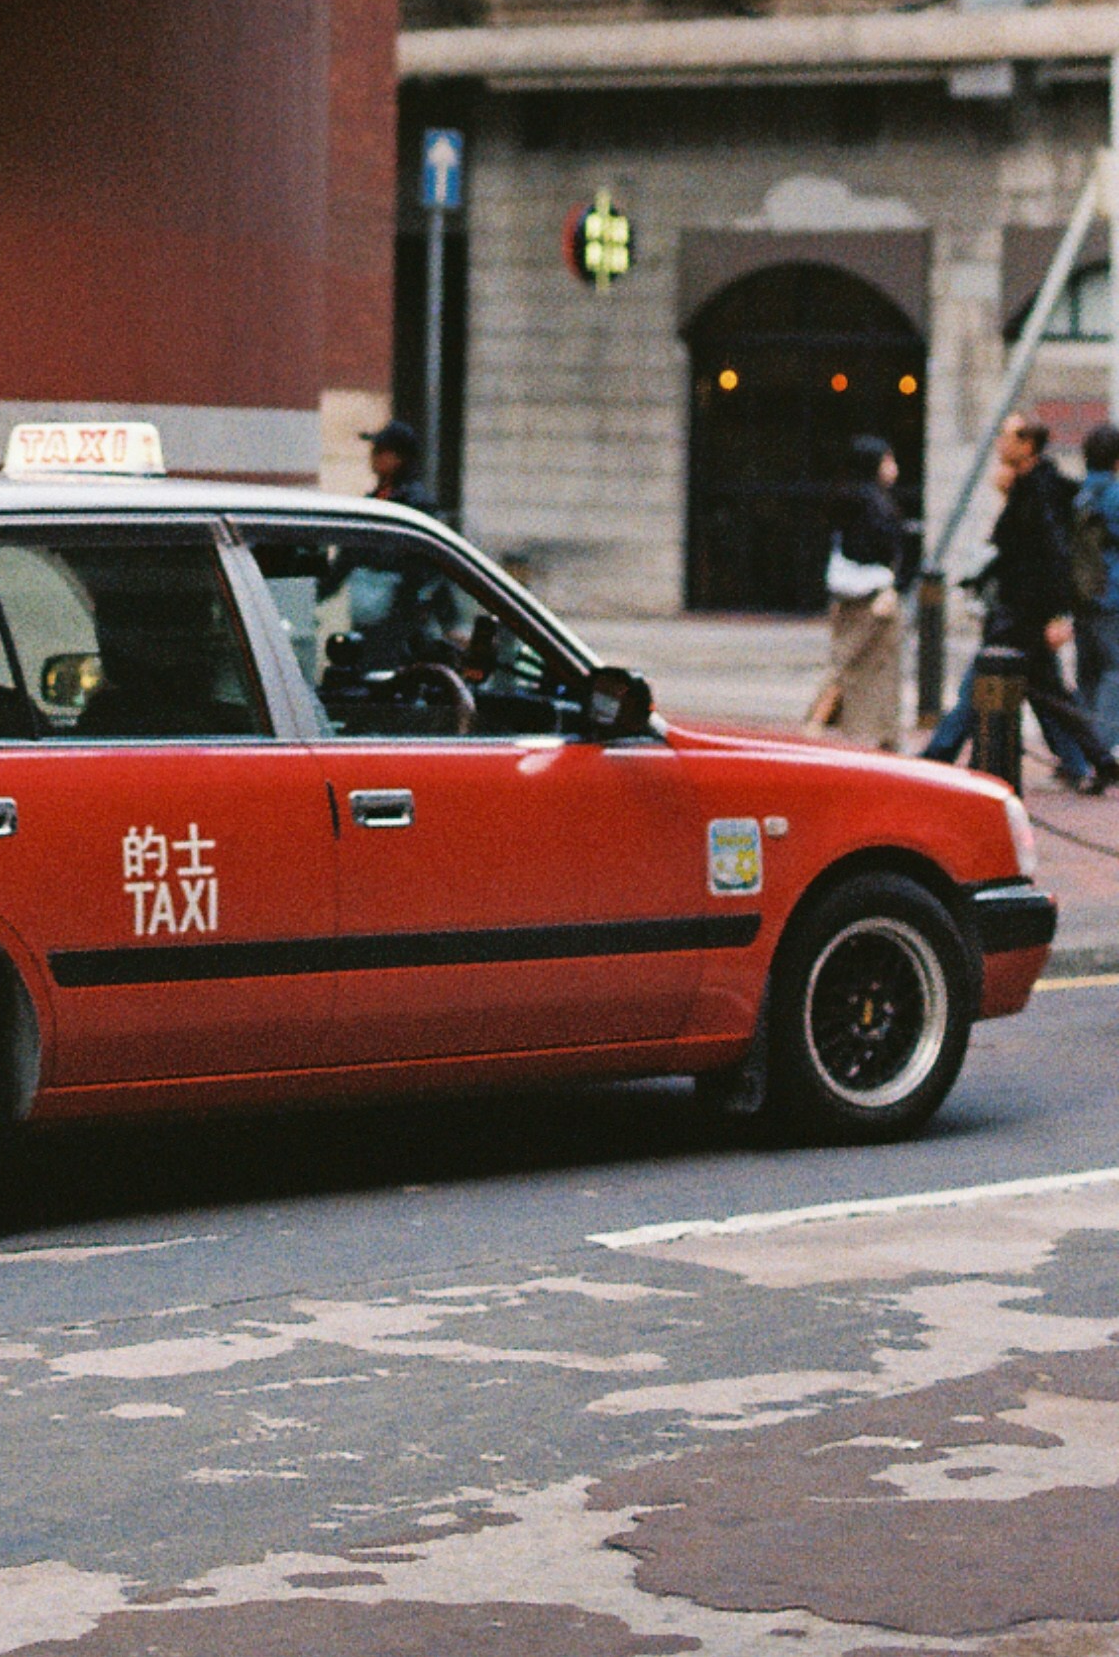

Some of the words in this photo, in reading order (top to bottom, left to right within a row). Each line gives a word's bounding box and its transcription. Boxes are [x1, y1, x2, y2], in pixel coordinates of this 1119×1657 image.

[19, 428, 128, 464] TAXI
[123, 822, 216, 878] 的士
[123, 878, 219, 936] TAXI
